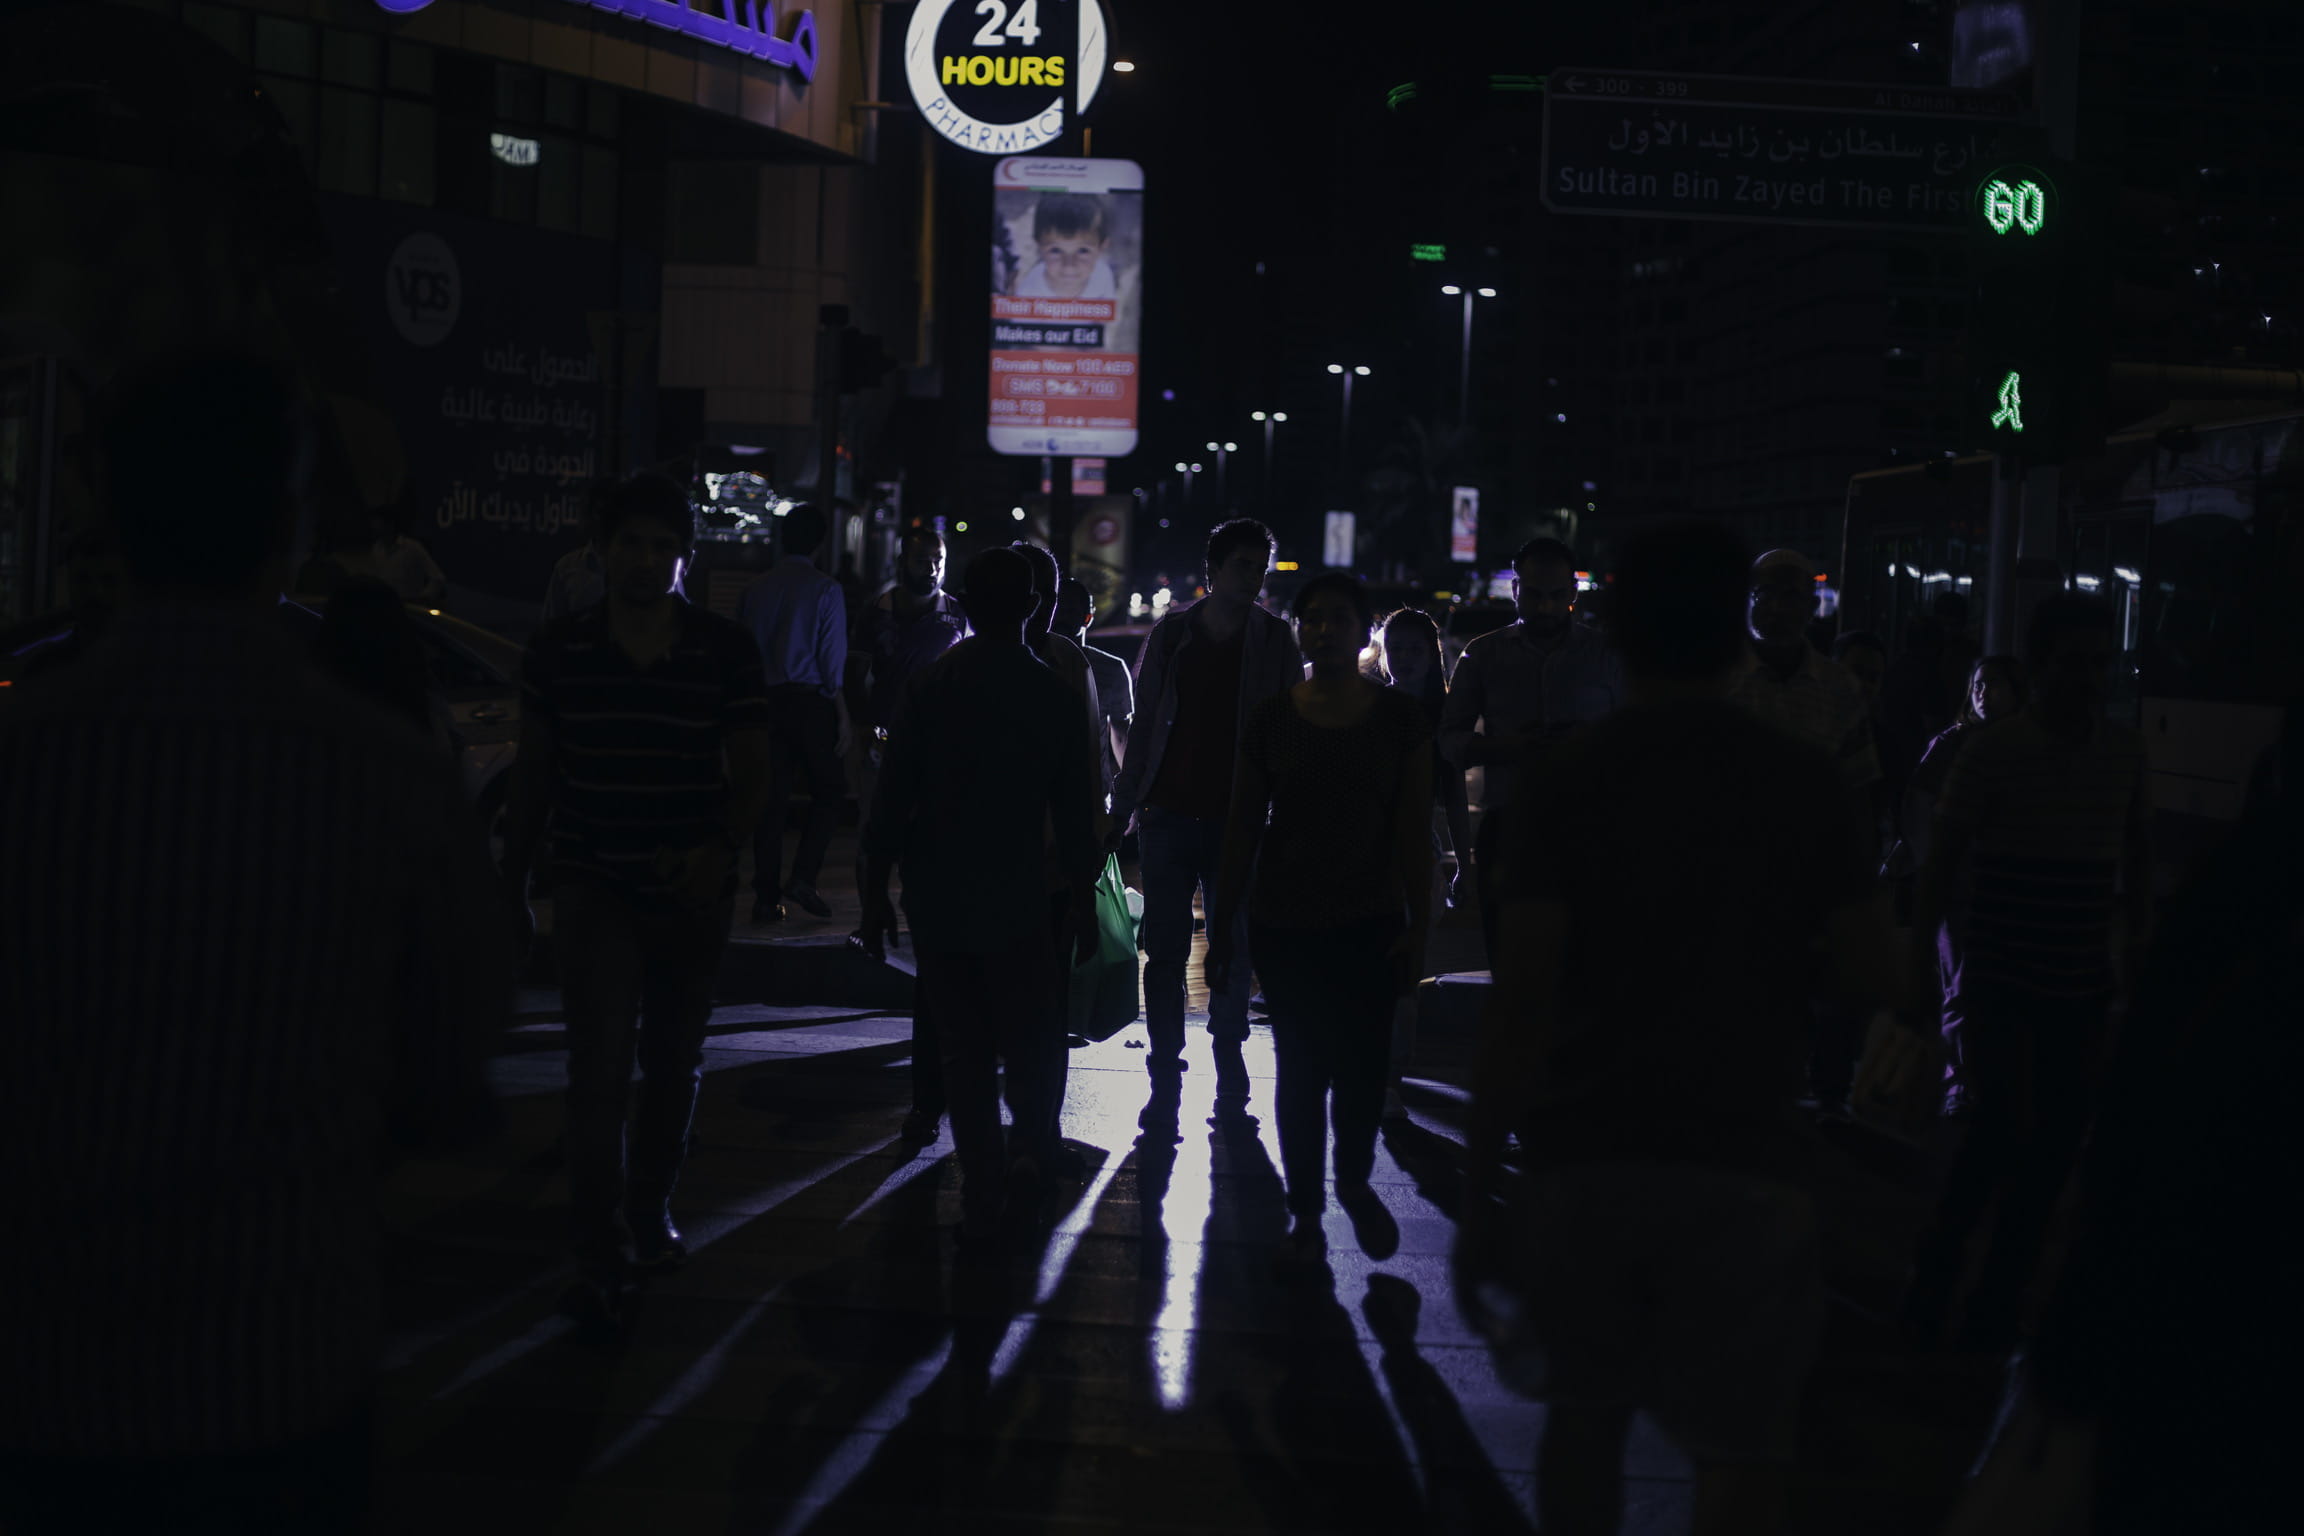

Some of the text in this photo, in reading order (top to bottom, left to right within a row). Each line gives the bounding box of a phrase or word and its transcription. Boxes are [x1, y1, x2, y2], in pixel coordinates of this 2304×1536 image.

[972, 0, 1041, 46] 24
[942, 55, 1064, 86] HOURS
[1592, 77, 1630, 96] 300
[1655, 79, 1688, 97] 399
[925, 96, 1064, 152] PHARMAC
[1607, 107, 1688, 157] الأول
[1696, 121, 1760, 160] زايد
[1818, 127, 1923, 160] سلطان
[1766, 127, 1809, 165] بن
[1558, 165, 1657, 197] Sultan
[1671, 169, 1720, 201] Bin
[1732, 173, 1825, 211] Zayed
[1838, 176, 1894, 210] The
[1033, 299, 1112, 319] Happiness
[994, 325, 1099, 345] Makes our Eid
[482, 340, 600, 389] الحصول على
[1042, 358, 1074, 375] Now
[1009, 377, 1045, 395] SMS
[440, 385, 497, 429] عالية
[552, 396, 598, 441] رعاية
[493, 442, 596, 488] الجودة في
[437, 479, 478, 530] الآن
